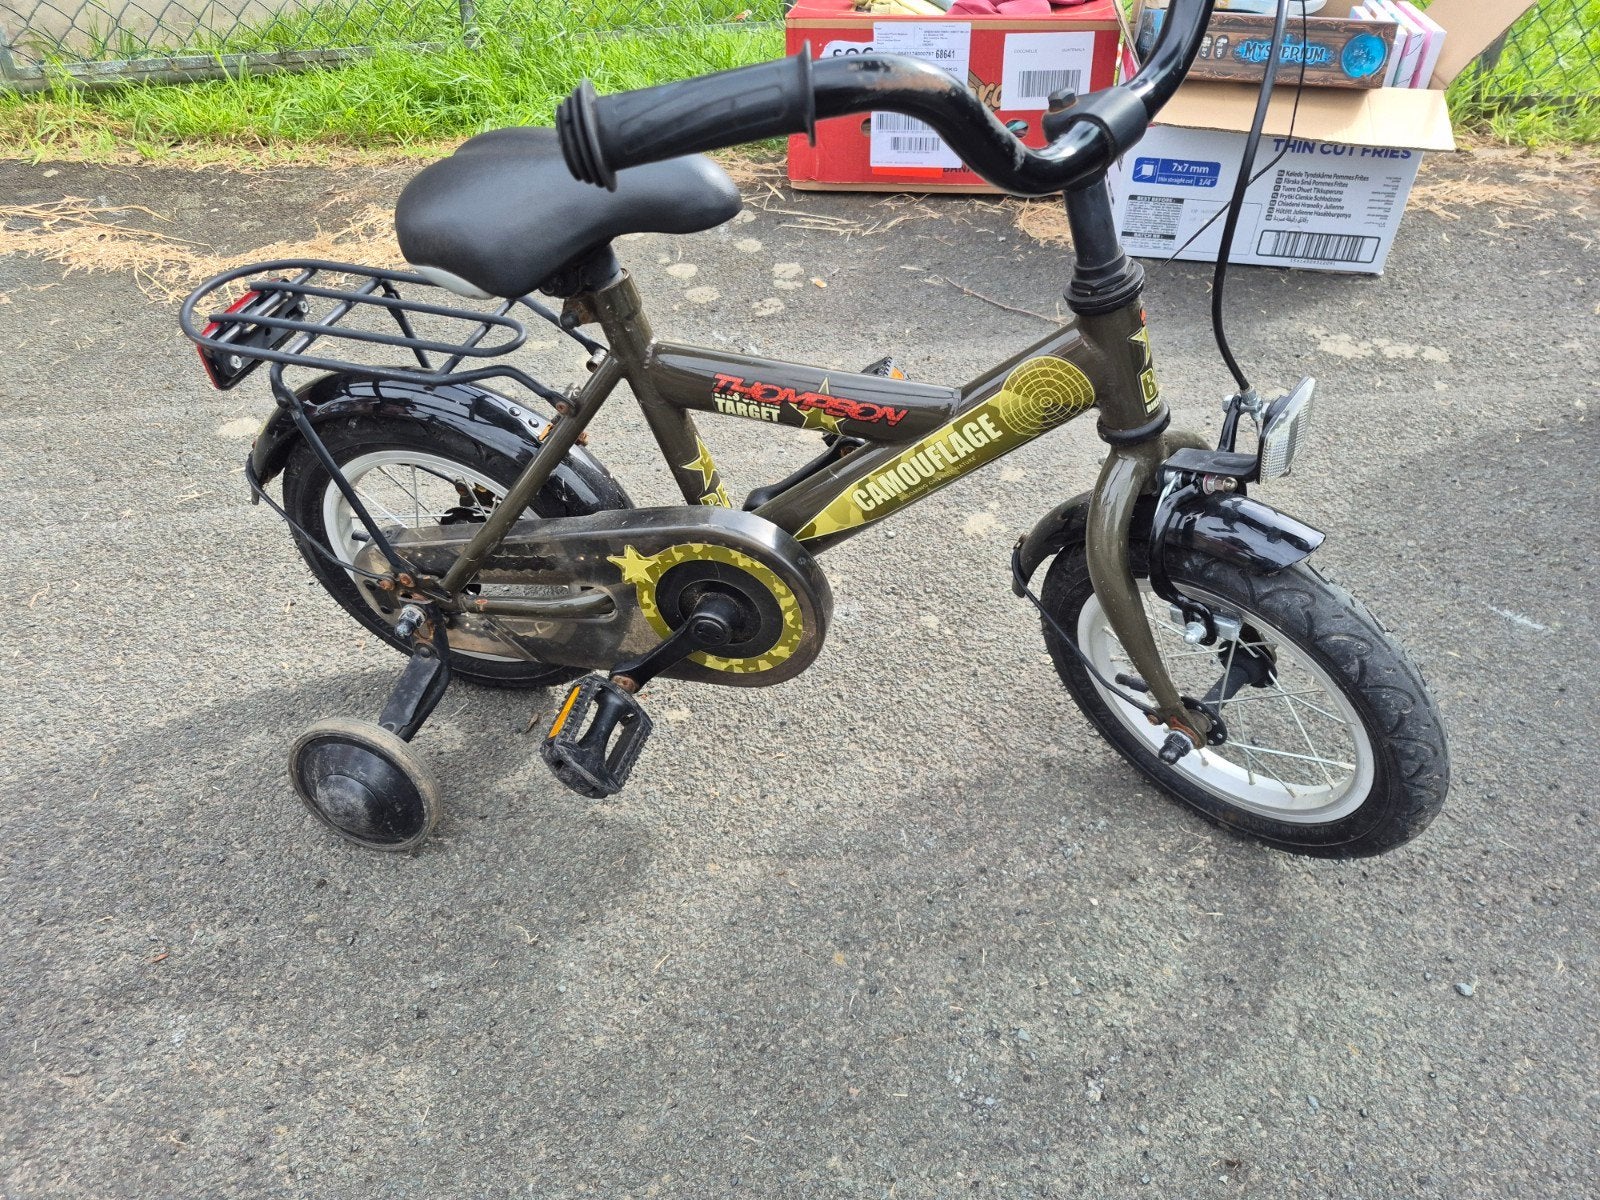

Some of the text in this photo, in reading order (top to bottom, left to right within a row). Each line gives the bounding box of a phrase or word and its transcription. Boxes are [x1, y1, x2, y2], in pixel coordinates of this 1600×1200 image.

[935, 49, 955, 59] 68641
[1274, 138, 1412, 159] THIN CUT FRIES
[1172, 162, 1209, 174] 7x7 mm
[713, 373, 909, 427] THOMPSON
[714, 397, 781, 423] TARGET
[852, 412, 1004, 511] CAMOUFLAGE
